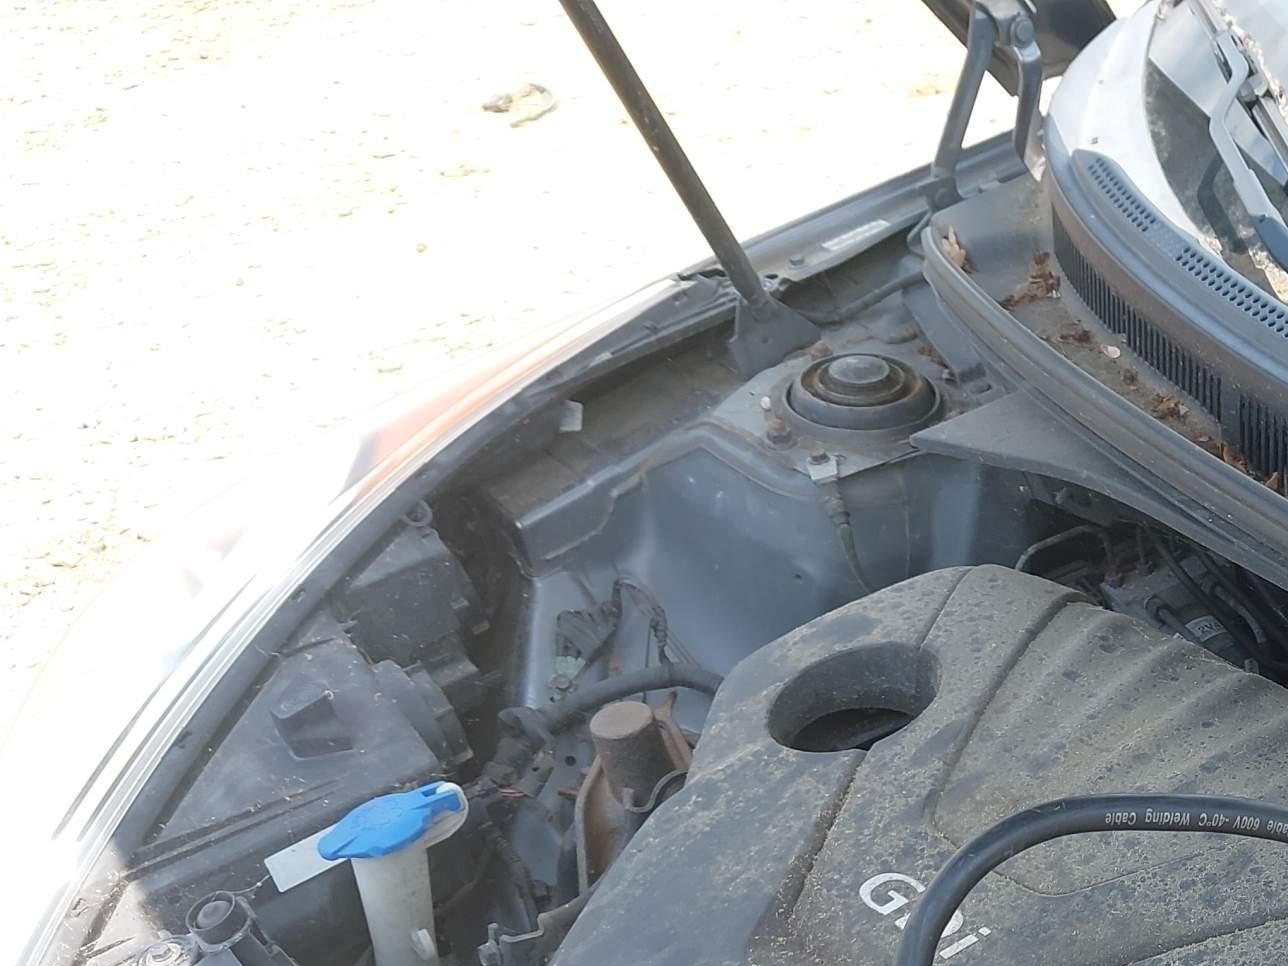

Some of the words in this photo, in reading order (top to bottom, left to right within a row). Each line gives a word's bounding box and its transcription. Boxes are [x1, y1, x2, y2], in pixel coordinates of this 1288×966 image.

[1104, 810, 1138, 825] Cable
[1144, 808, 1191, 826] Welding
[1232, 815, 1261, 831] 600V
